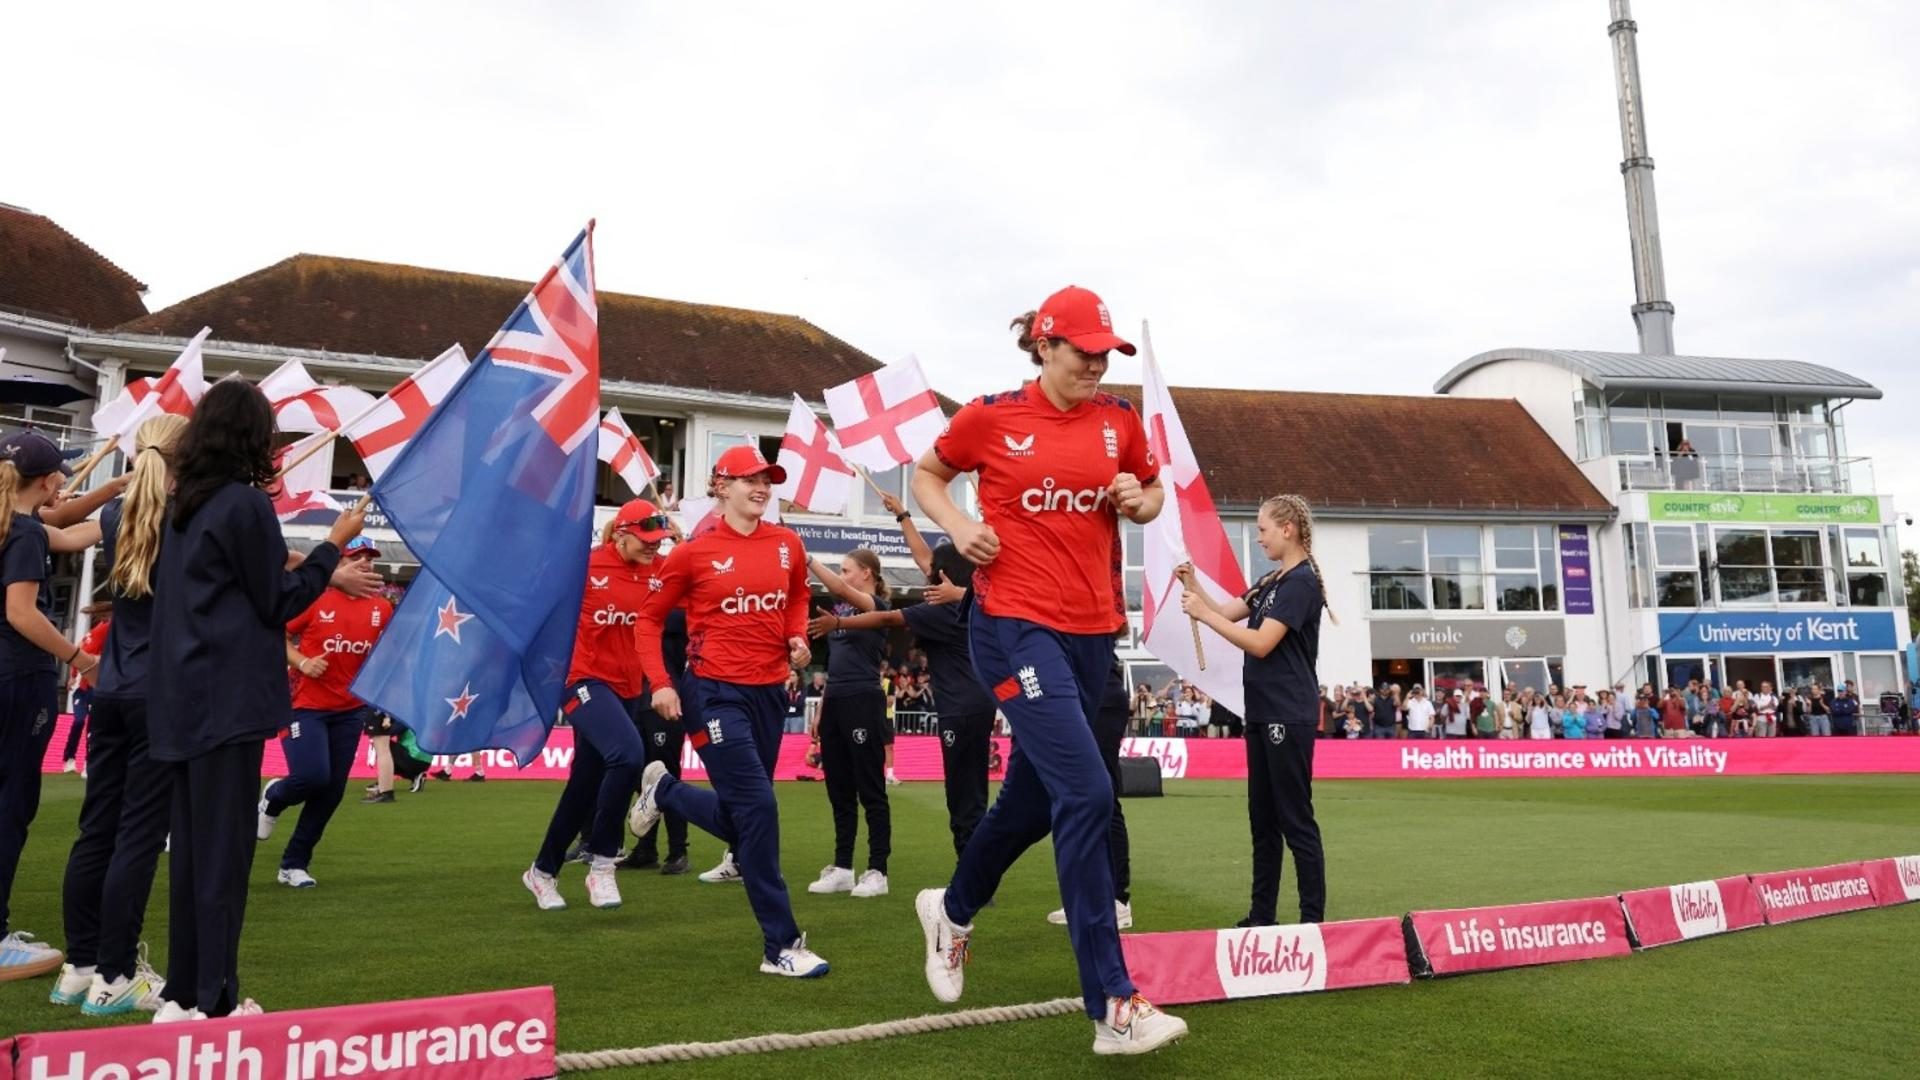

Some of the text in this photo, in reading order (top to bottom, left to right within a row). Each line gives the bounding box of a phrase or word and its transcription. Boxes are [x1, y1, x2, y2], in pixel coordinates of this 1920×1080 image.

[824, 528, 840, 539] the
[841, 529, 877, 543] beating
[879, 532, 905, 543] heart
[858, 541, 869, 551] of
[593, 603, 639, 625] cinc
[1410, 626, 1463, 644] oriole
[1699, 617, 1860, 647] University of Kent
[1401, 745, 1727, 774] Health insurance with Vitality
[1676, 885, 1719, 928] Vitality
[1760, 876, 1869, 910] Health insurance
[1445, 918, 1606, 955] Life insurance
[1228, 929, 1313, 985] Vitality
[286, 1018, 547, 1080] insurance
